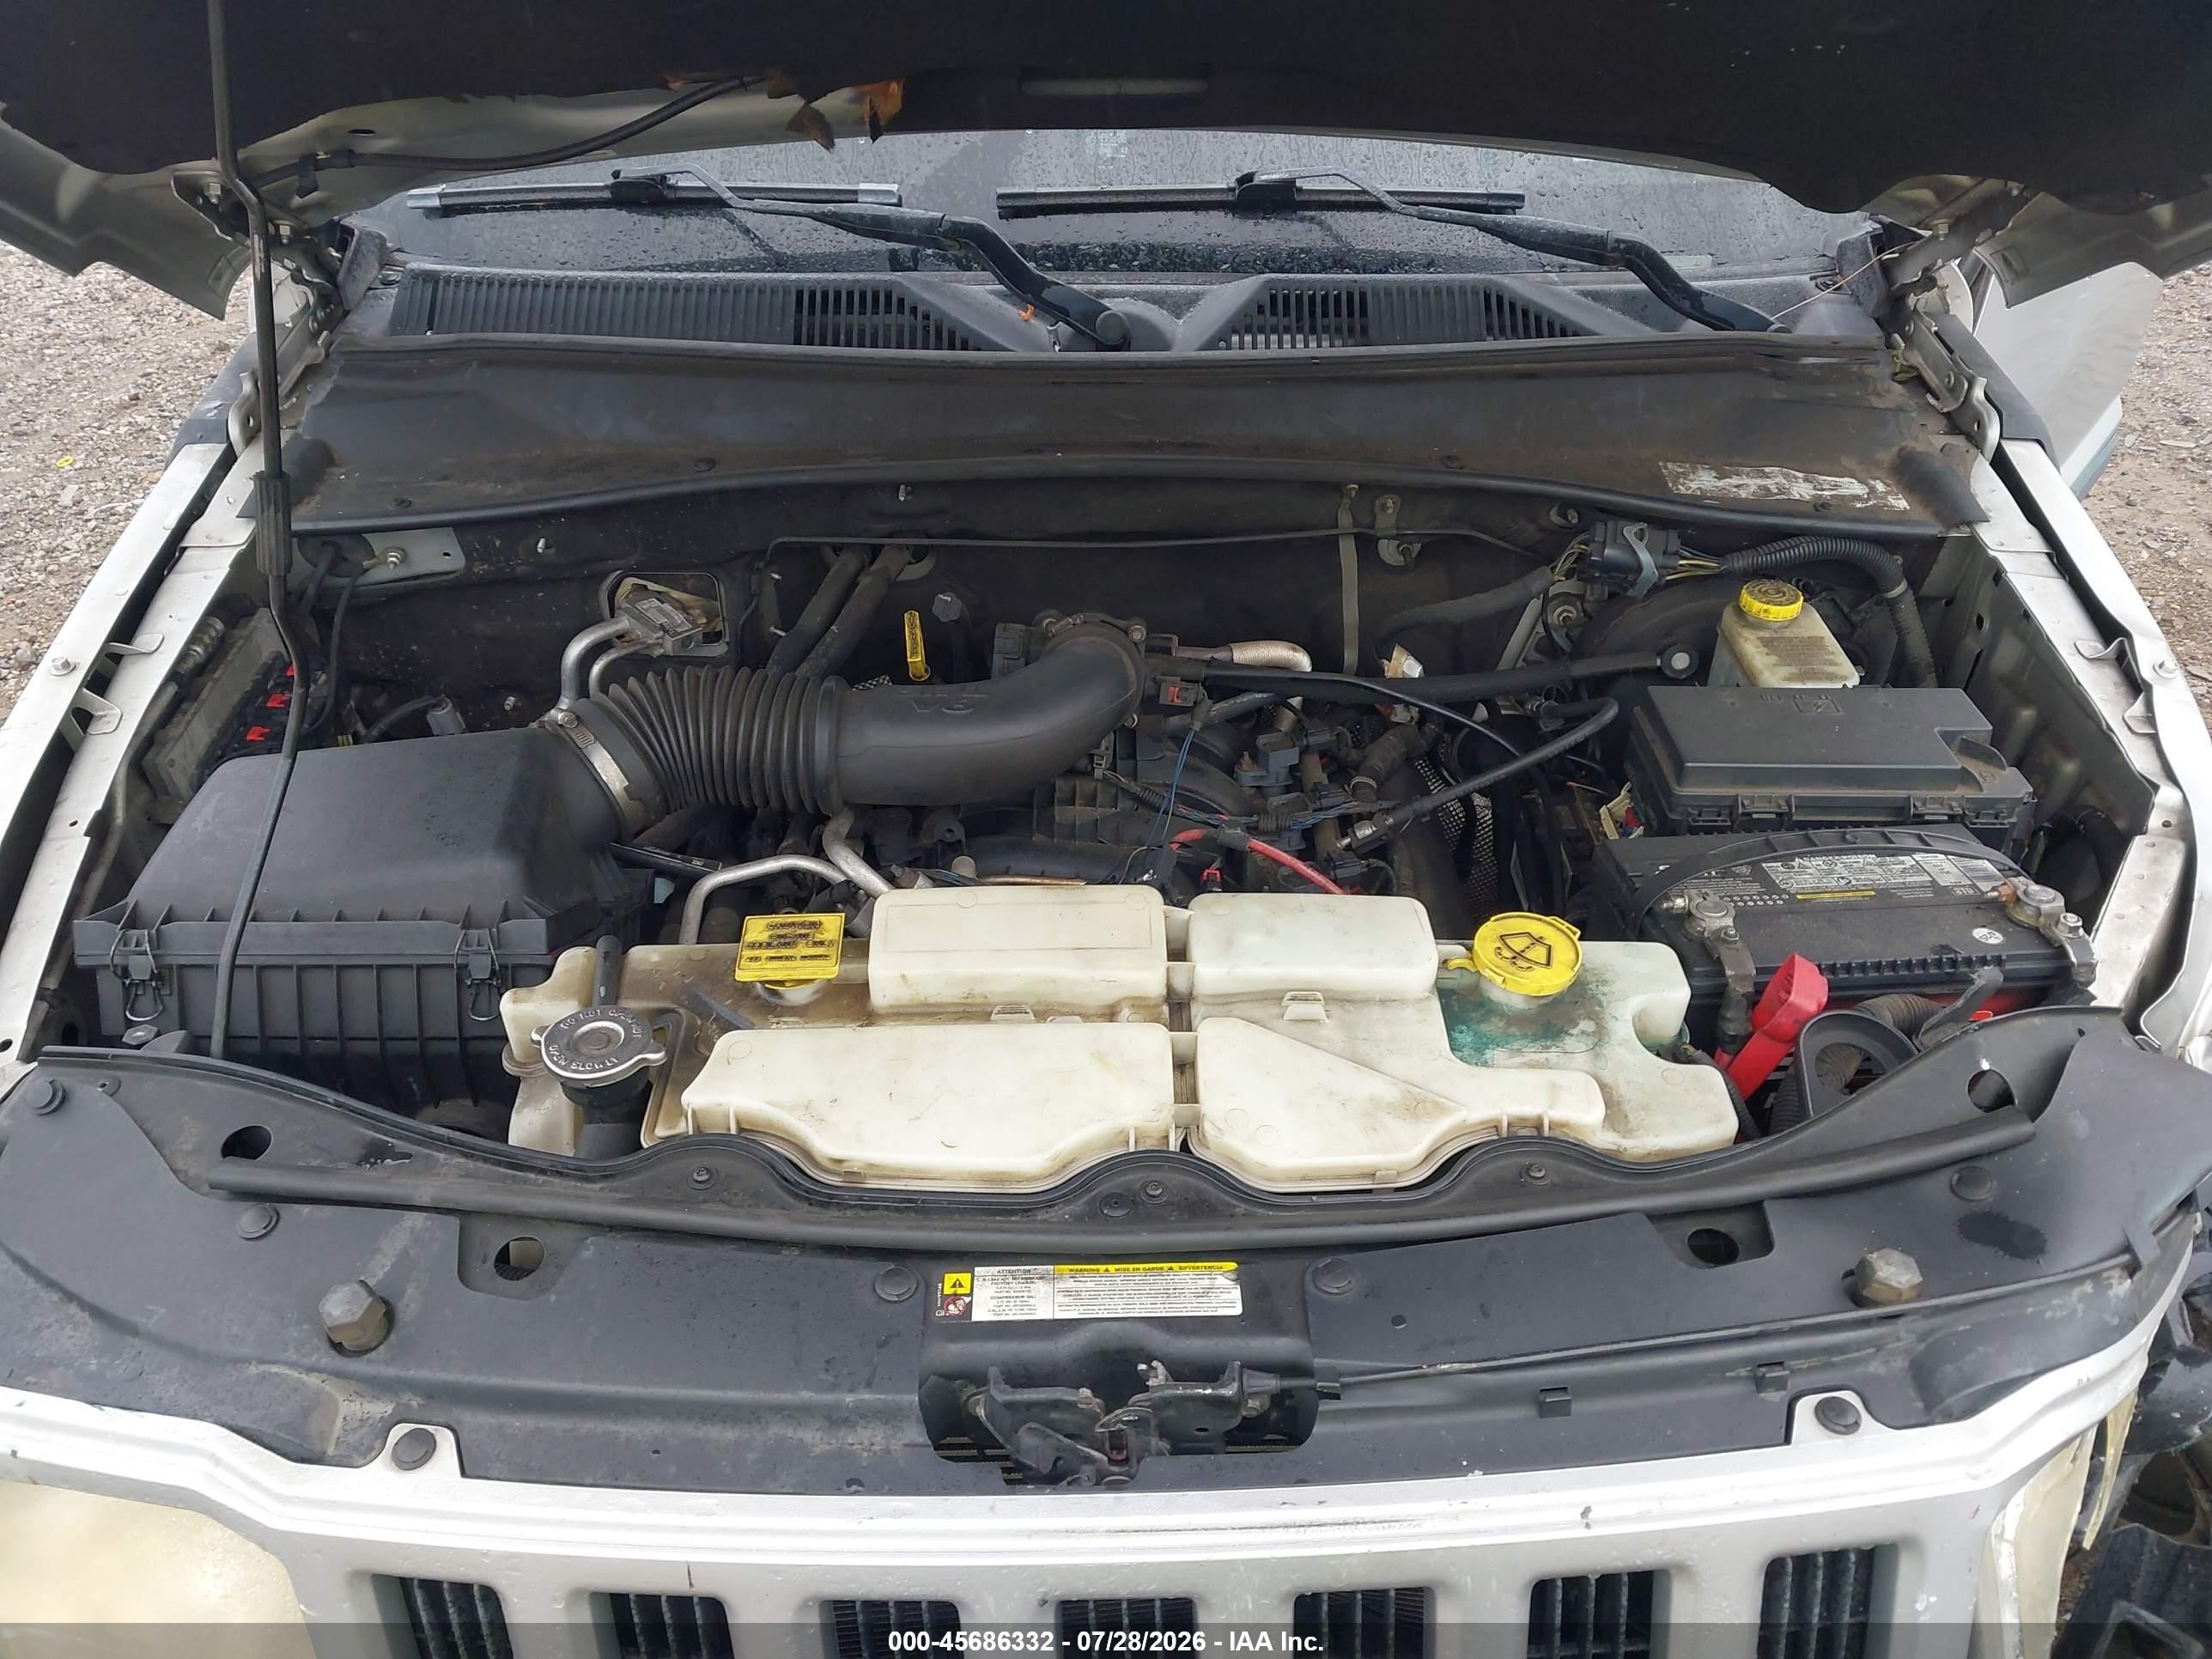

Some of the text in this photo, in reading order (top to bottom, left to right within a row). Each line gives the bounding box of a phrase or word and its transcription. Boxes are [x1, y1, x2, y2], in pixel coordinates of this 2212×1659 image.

[559, 1017, 577, 1030] DO
[579, 1009, 602, 1020] NOT
[549, 1043, 570, 1066] OPEN
